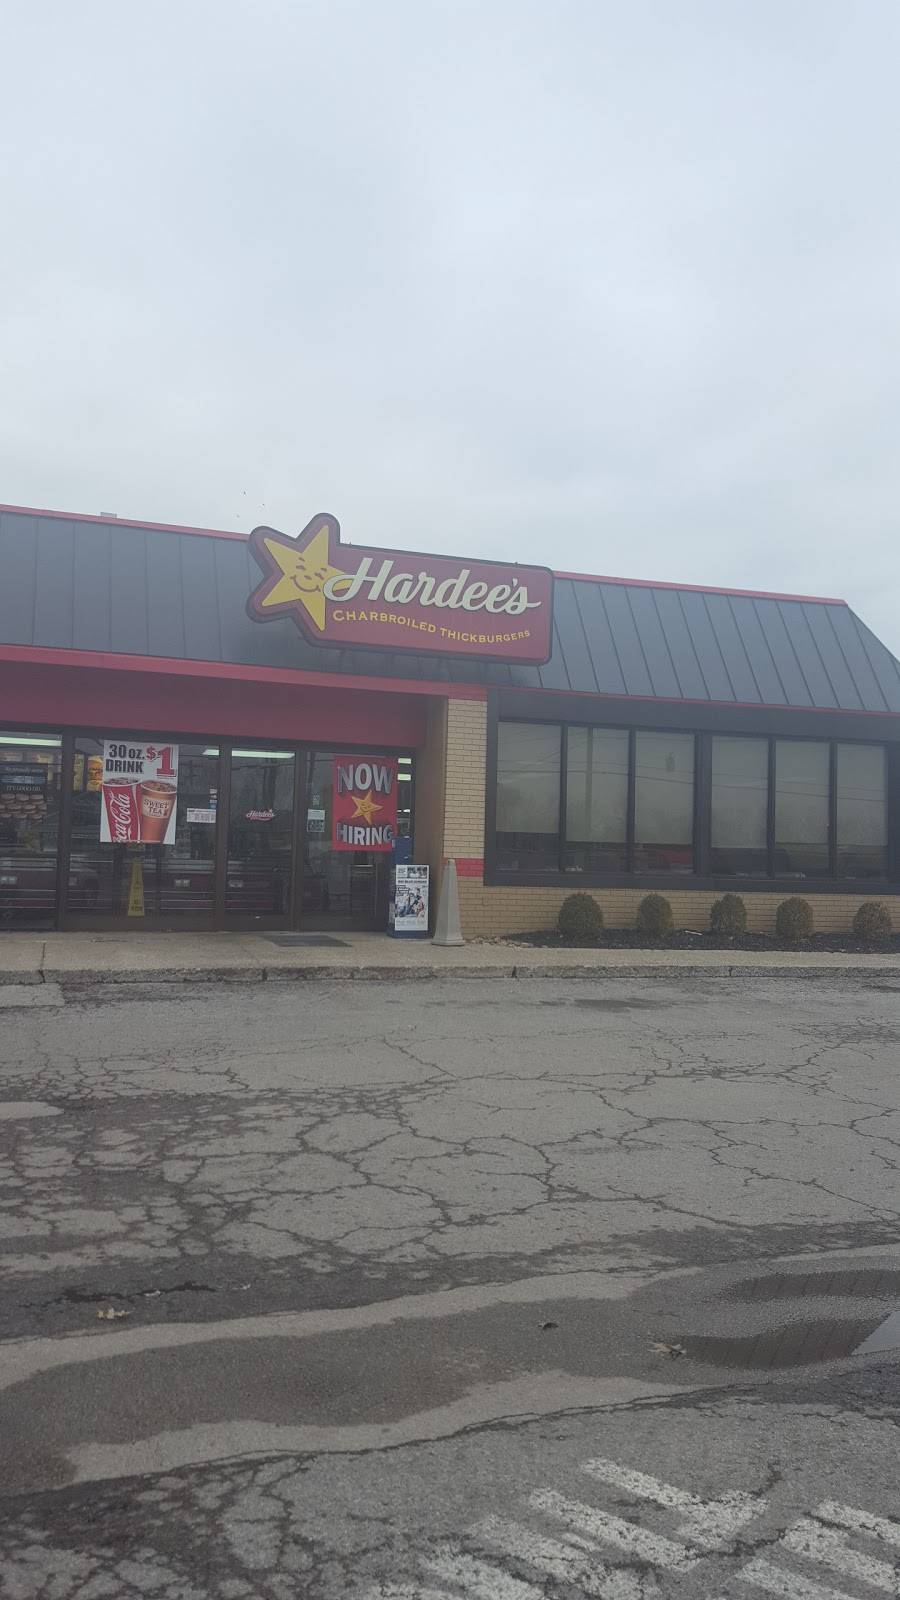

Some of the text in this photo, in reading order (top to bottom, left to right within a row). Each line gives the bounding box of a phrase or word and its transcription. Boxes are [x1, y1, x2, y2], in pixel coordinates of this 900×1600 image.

[323, 557, 541, 615] Hardee's
[332, 609, 530, 643] CHARBROILED THICKBURGERS
[108, 744, 145, 760] 30 oz.
[146, 746, 176, 777] $1
[105, 759, 144, 773] DRINK
[337, 763, 393, 794] NOW
[143, 798, 169, 809] SWEET
[148, 806, 162, 815] TEA
[336, 822, 394, 846] HIRING
